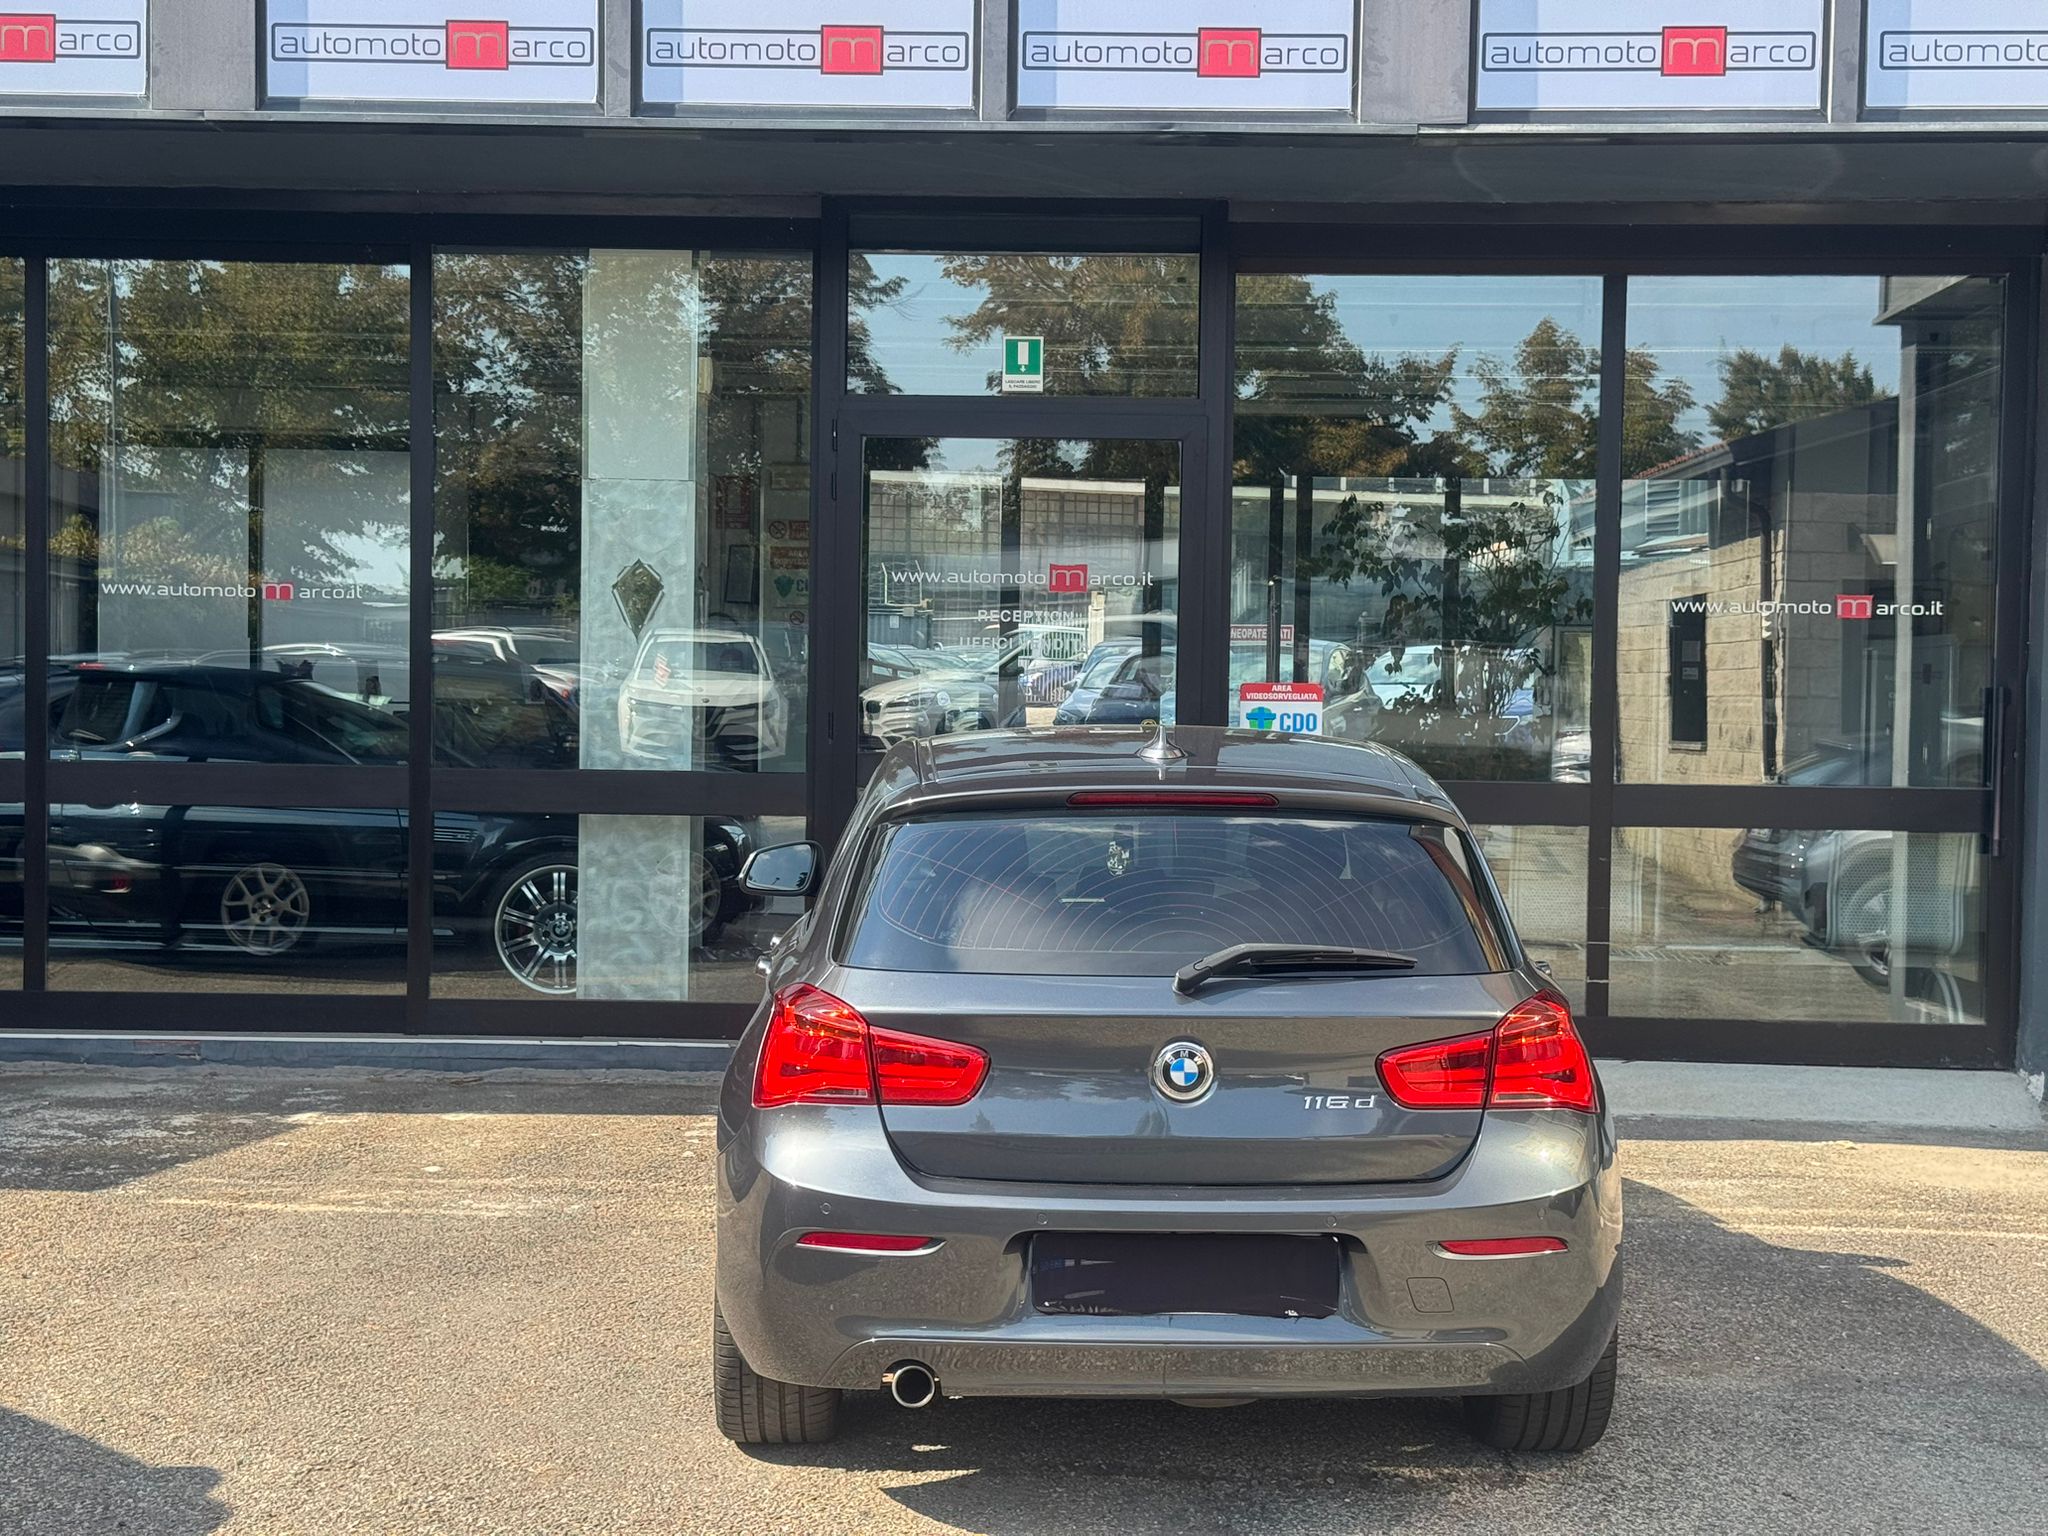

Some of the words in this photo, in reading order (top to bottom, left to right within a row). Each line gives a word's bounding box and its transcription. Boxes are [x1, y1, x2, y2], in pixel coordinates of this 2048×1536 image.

[977, 609, 1074, 623] RECEPTION
[1230, 628, 1291, 640] NEOPATETI
[1271, 684, 1293, 692] AREA
[1245, 692, 1319, 700] VIDEOSORVEGLIATA
[1279, 712, 1318, 732] CDO
